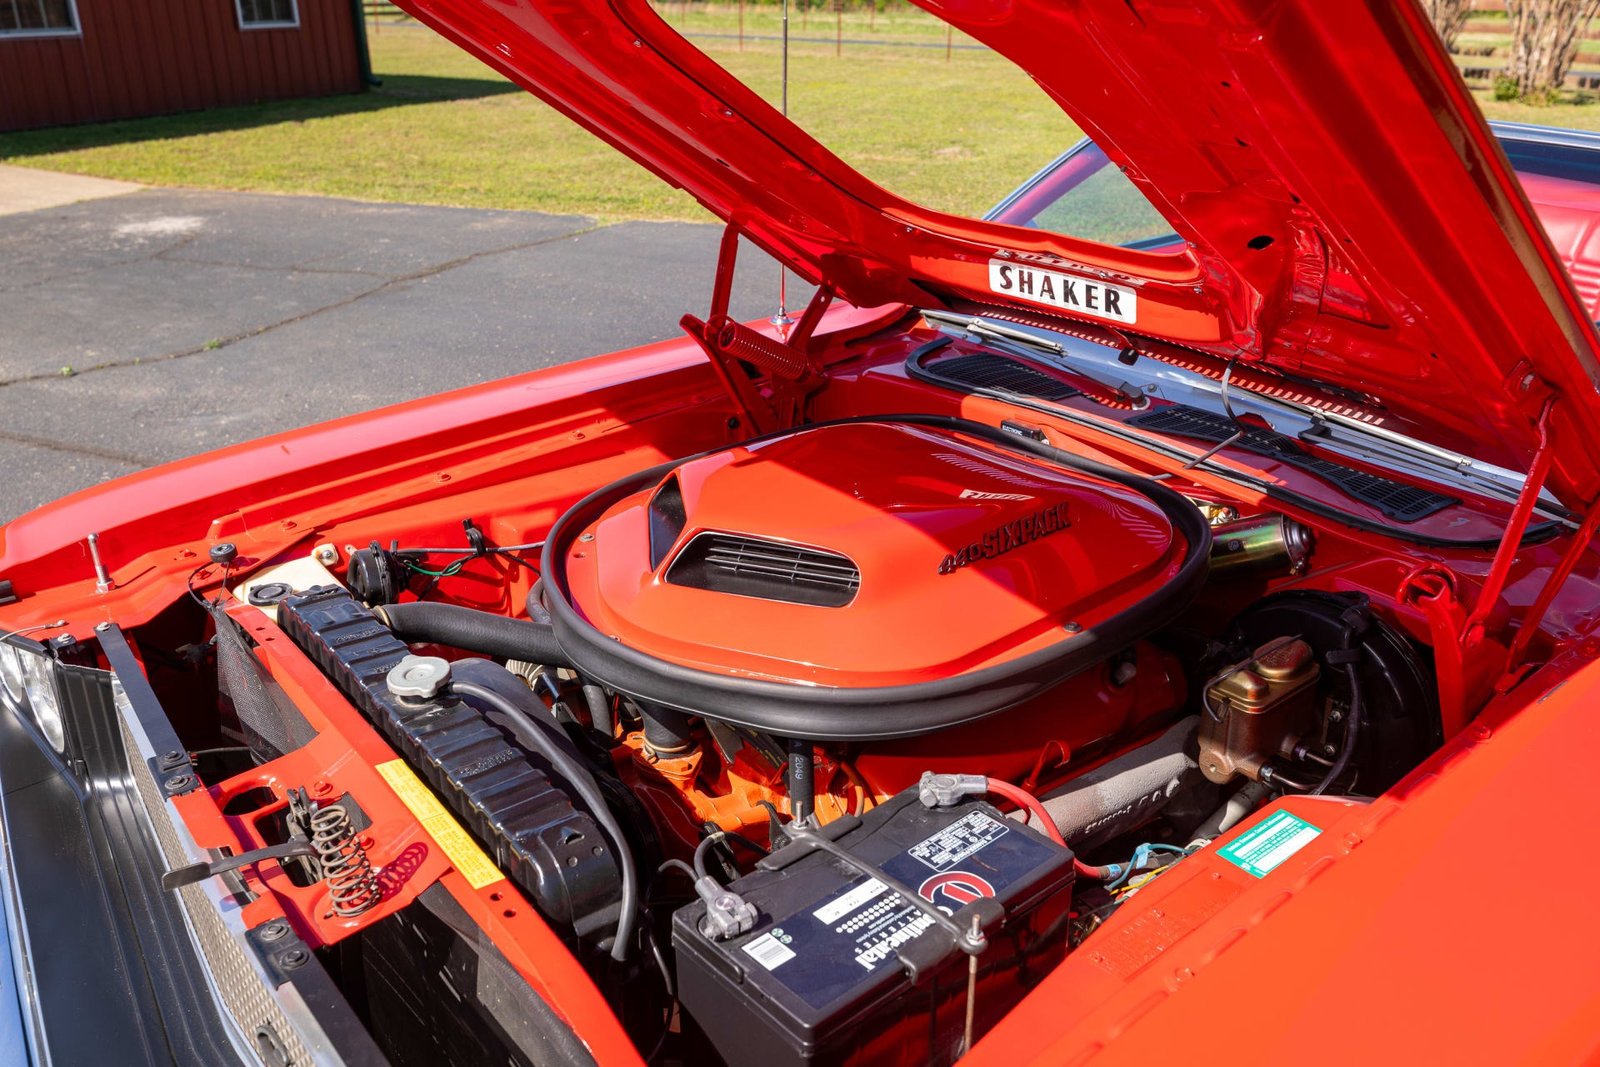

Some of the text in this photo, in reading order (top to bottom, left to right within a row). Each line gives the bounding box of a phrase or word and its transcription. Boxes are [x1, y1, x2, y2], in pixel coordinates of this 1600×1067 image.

[999, 265, 1122, 316] SHAKER
[795, 756, 804, 780] 2049
[855, 909, 922, 955] ATTERIES
